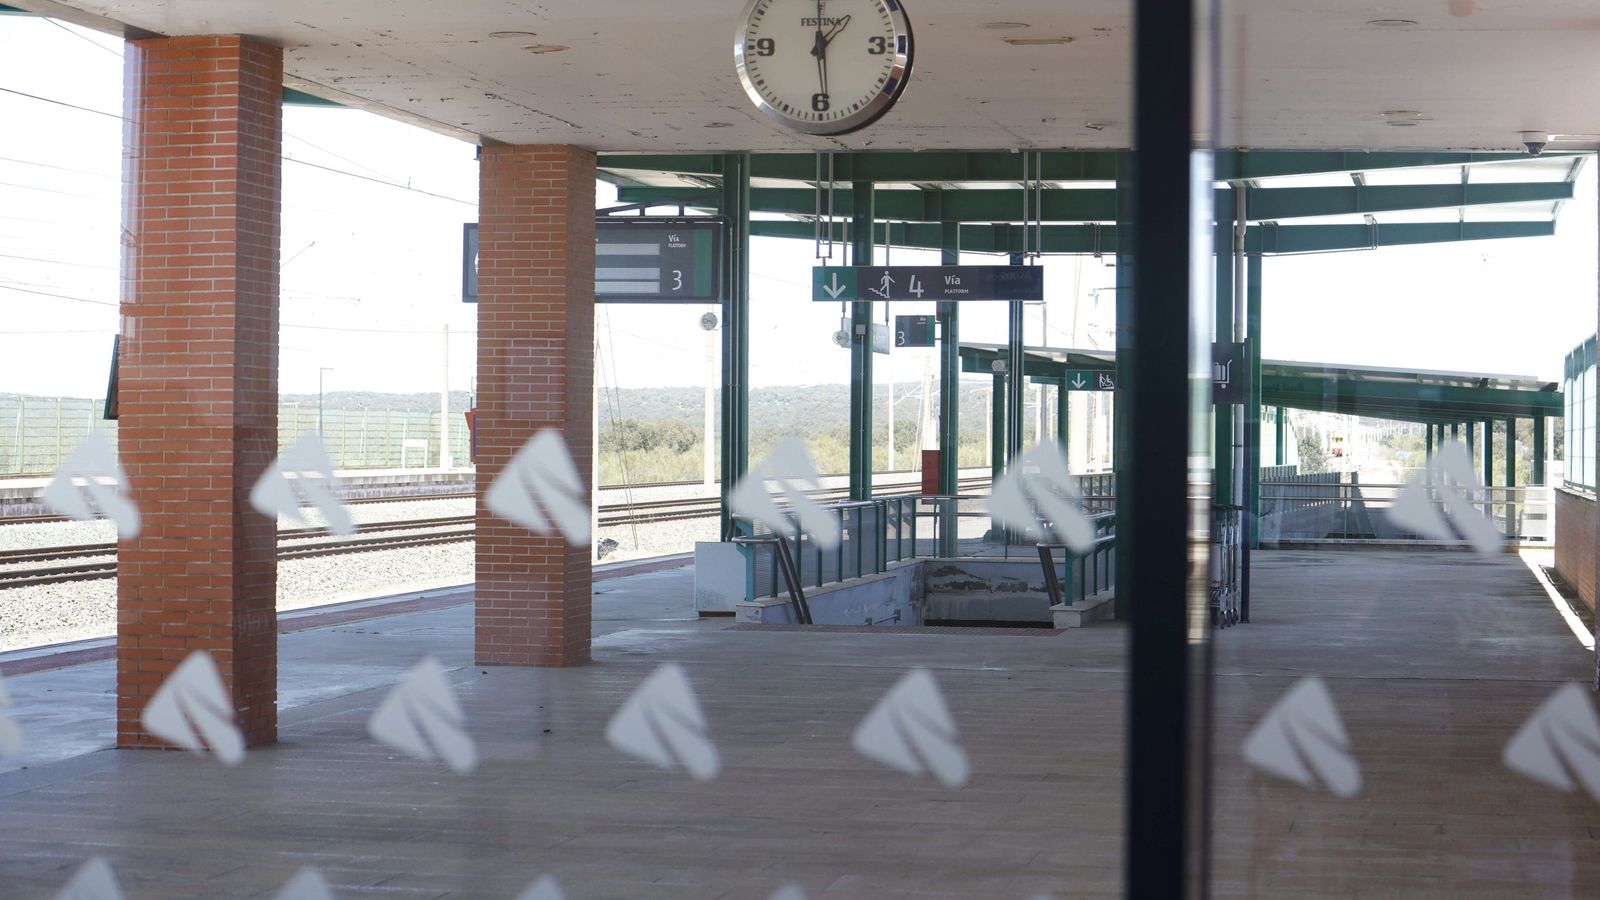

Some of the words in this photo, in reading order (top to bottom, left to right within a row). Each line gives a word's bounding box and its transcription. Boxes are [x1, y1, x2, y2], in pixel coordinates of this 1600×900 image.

[801, 17, 842, 26] FESTINA
[756, 38, 775, 57] 9
[867, 36, 886, 55] 3
[811, 93, 830, 112] 6
[672, 269, 682, 291] 3
[909, 274, 925, 298] 4
[944, 274, 961, 285] Vía
[897, 330, 905, 346] 3
